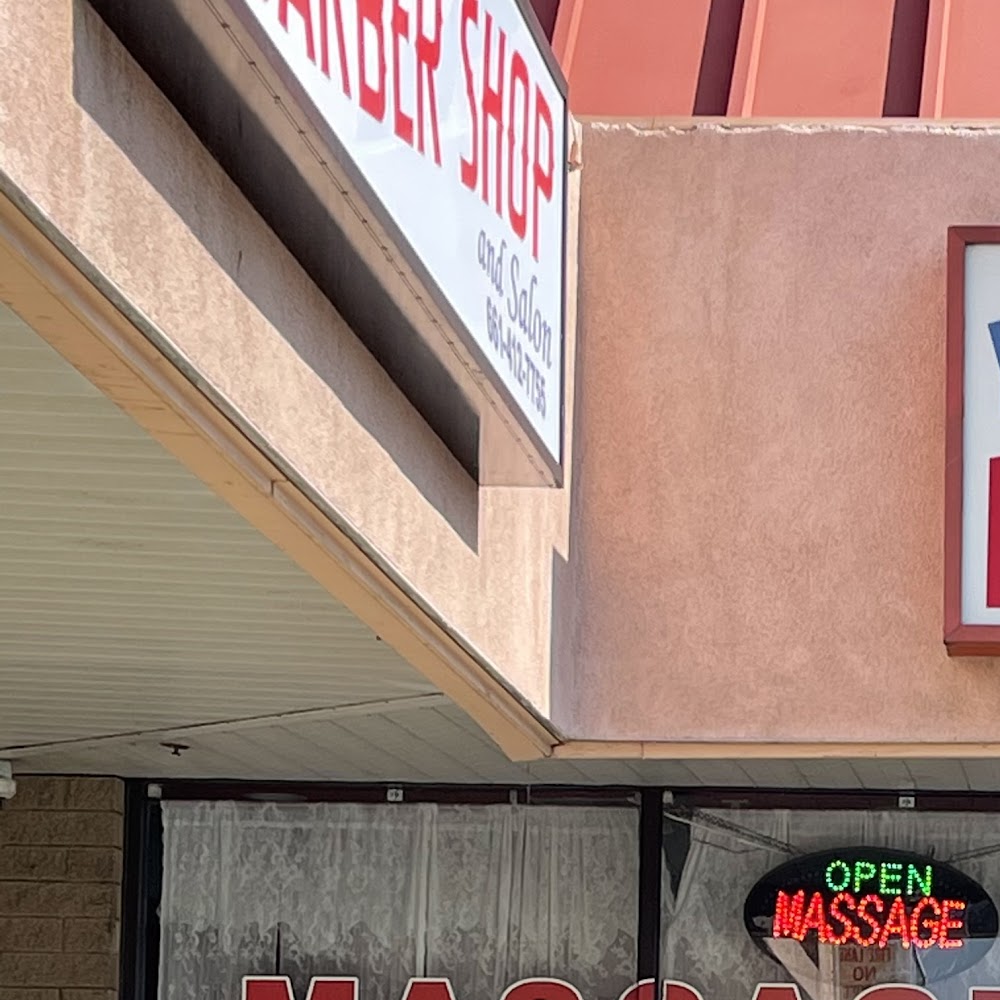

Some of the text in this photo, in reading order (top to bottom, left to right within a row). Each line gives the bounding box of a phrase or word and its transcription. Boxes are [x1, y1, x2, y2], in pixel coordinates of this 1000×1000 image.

[460, 0, 555, 264] SHOP
[478, 230, 552, 370] and Salon
[772, 890, 966, 949] MASSAGE
[825, 860, 933, 896] OPEN
